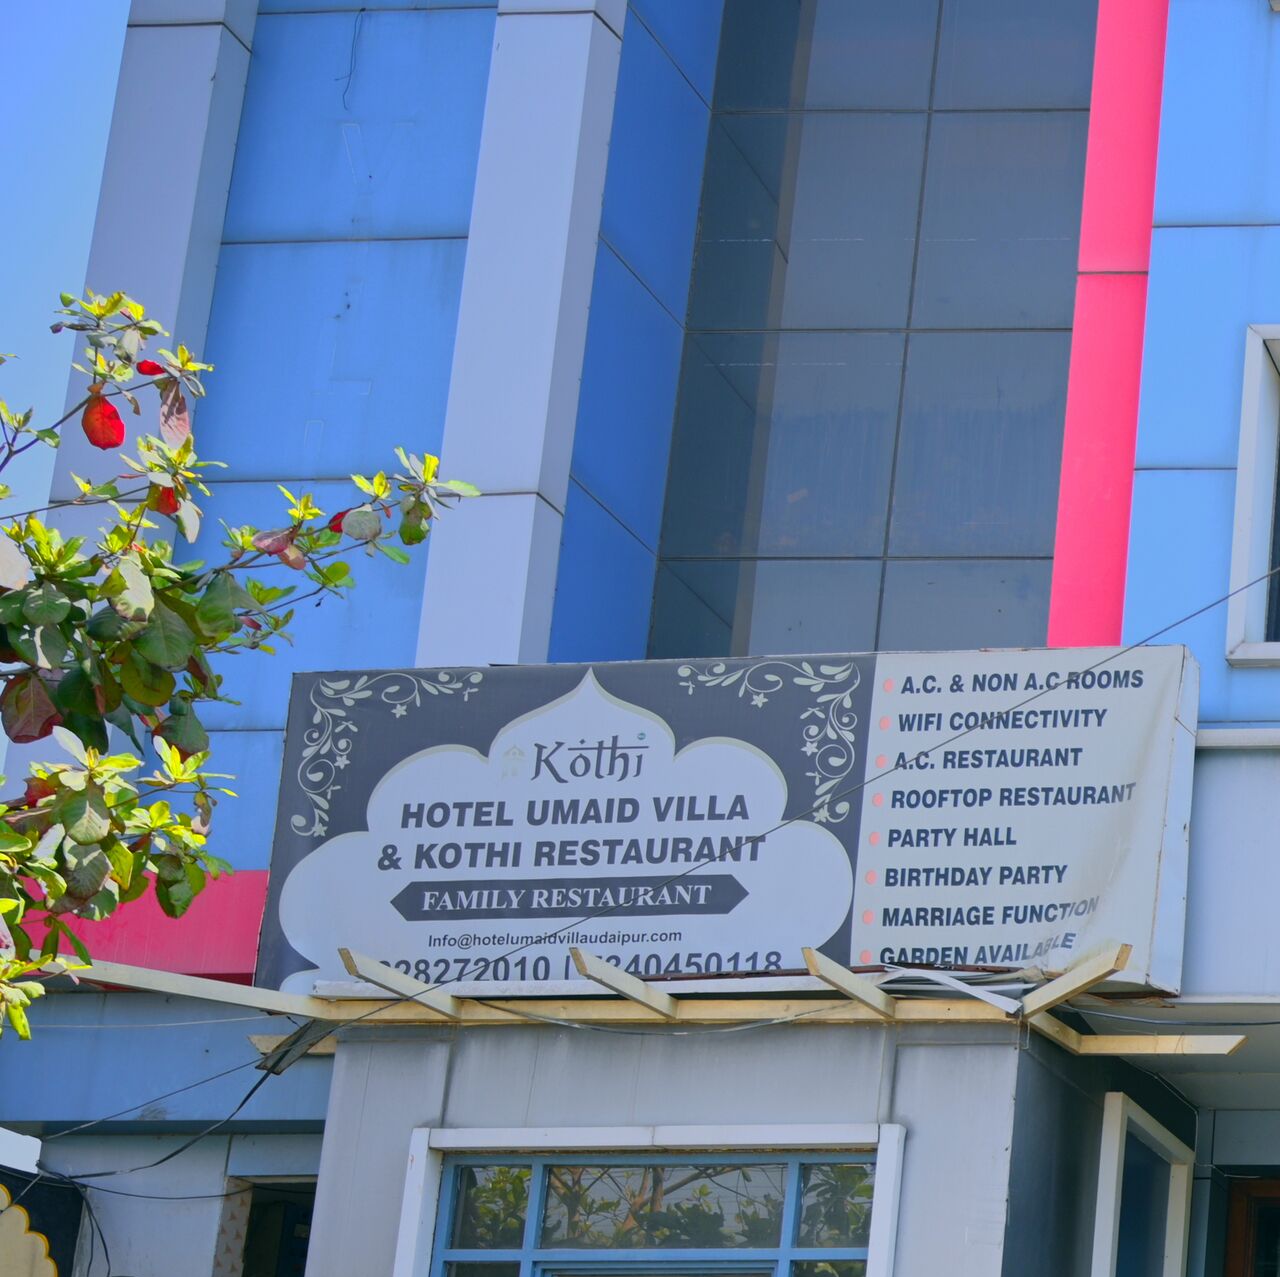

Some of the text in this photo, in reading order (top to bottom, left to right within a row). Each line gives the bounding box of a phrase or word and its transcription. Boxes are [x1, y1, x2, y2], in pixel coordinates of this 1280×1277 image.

[901, 675, 942, 694] A.C.
[950, 675, 964, 692] &
[972, 673, 1018, 693] NON
[1066, 669, 1144, 690] ROOMS
[898, 708, 1108, 732] WIFI CONNECTIVITY
[895, 747, 1083, 769] A.C. RESTAURANT
[891, 782, 1136, 808] ROOFTOP RESTAURANT
[400, 794, 750, 829] HOTEL UMAID VILLA
[887, 827, 1017, 847] PARTY HALL
[377, 835, 766, 871] & KOTHI RESTAURANT
[884, 865, 1068, 887] BIRTHDAY PARTY
[422, 884, 712, 912] FAMILY RESTAURANT
[881, 896, 1099, 927] MARRIAGE FUNCTION
[427, 930, 682, 949] Info@hotelumaidvillaudaipur.com
[880, 932, 1076, 965] GARDEN AVAILABLE
